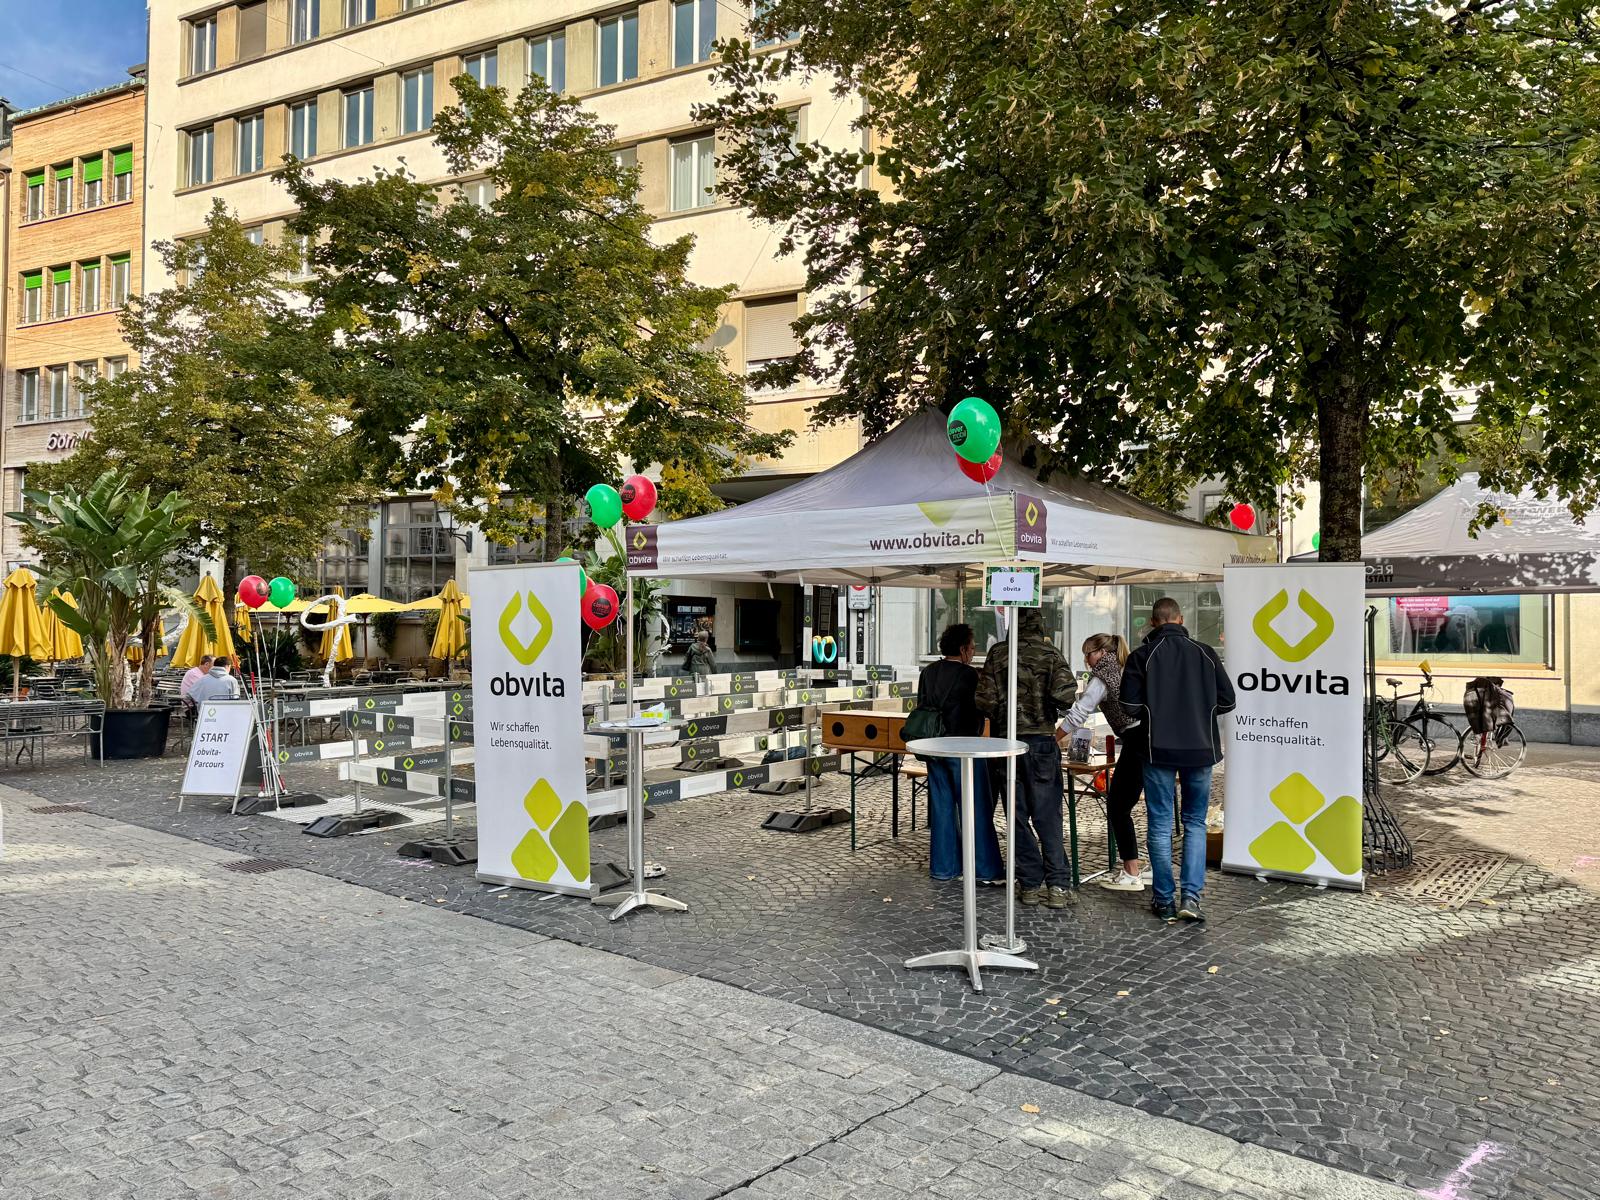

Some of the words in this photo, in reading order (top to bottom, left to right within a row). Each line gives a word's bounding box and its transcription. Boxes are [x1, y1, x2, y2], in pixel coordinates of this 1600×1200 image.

[869, 528, 985, 551] www.obvita.ch
[1020, 532, 1042, 544] obvita
[628, 555, 652, 564] obvita
[1009, 576, 1015, 584] 6
[490, 671, 565, 697] obvita
[1237, 667, 1349, 695] obvita
[490, 721, 504, 731] Wir
[506, 721, 540, 732] schaffen
[1235, 715, 1257, 726] Wir
[1259, 716, 1308, 729] schaffen
[199, 732, 230, 743] START
[1235, 731, 1325, 747] Lebensqualität.
[490, 737, 552, 750] Lebensqualität.
[196, 748, 222, 756] obvita-
[193, 760, 225, 768] Parcours
[653, 789, 674, 797] obvita
